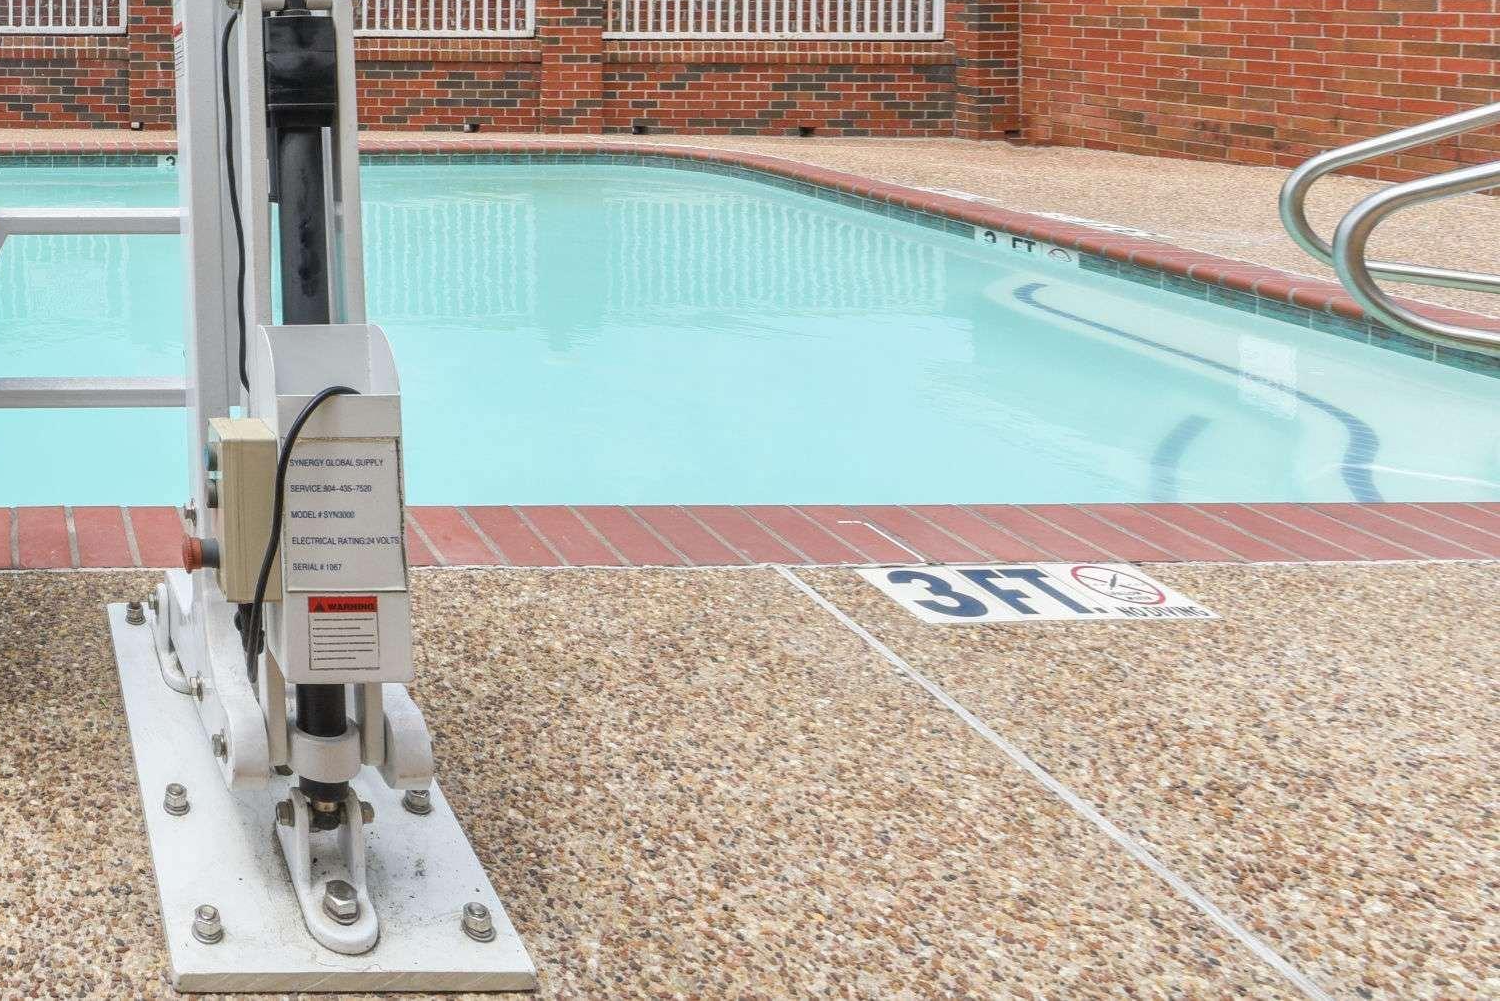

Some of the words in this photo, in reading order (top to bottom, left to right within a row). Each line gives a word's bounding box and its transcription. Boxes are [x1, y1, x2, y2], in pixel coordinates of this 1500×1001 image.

[289, 458, 324, 467] SYNERGY
[325, 458, 353, 467] GLOBAL
[355, 458, 384, 467] SUPPLY
[291, 510, 316, 519] MODEL
[291, 536, 336, 545] ELECTRICAL
[376, 536, 400, 545] VOLTS
[292, 563, 320, 571] SERIAL
[887, 570, 988, 618] 3
[1115, 606, 1148, 617] NO
